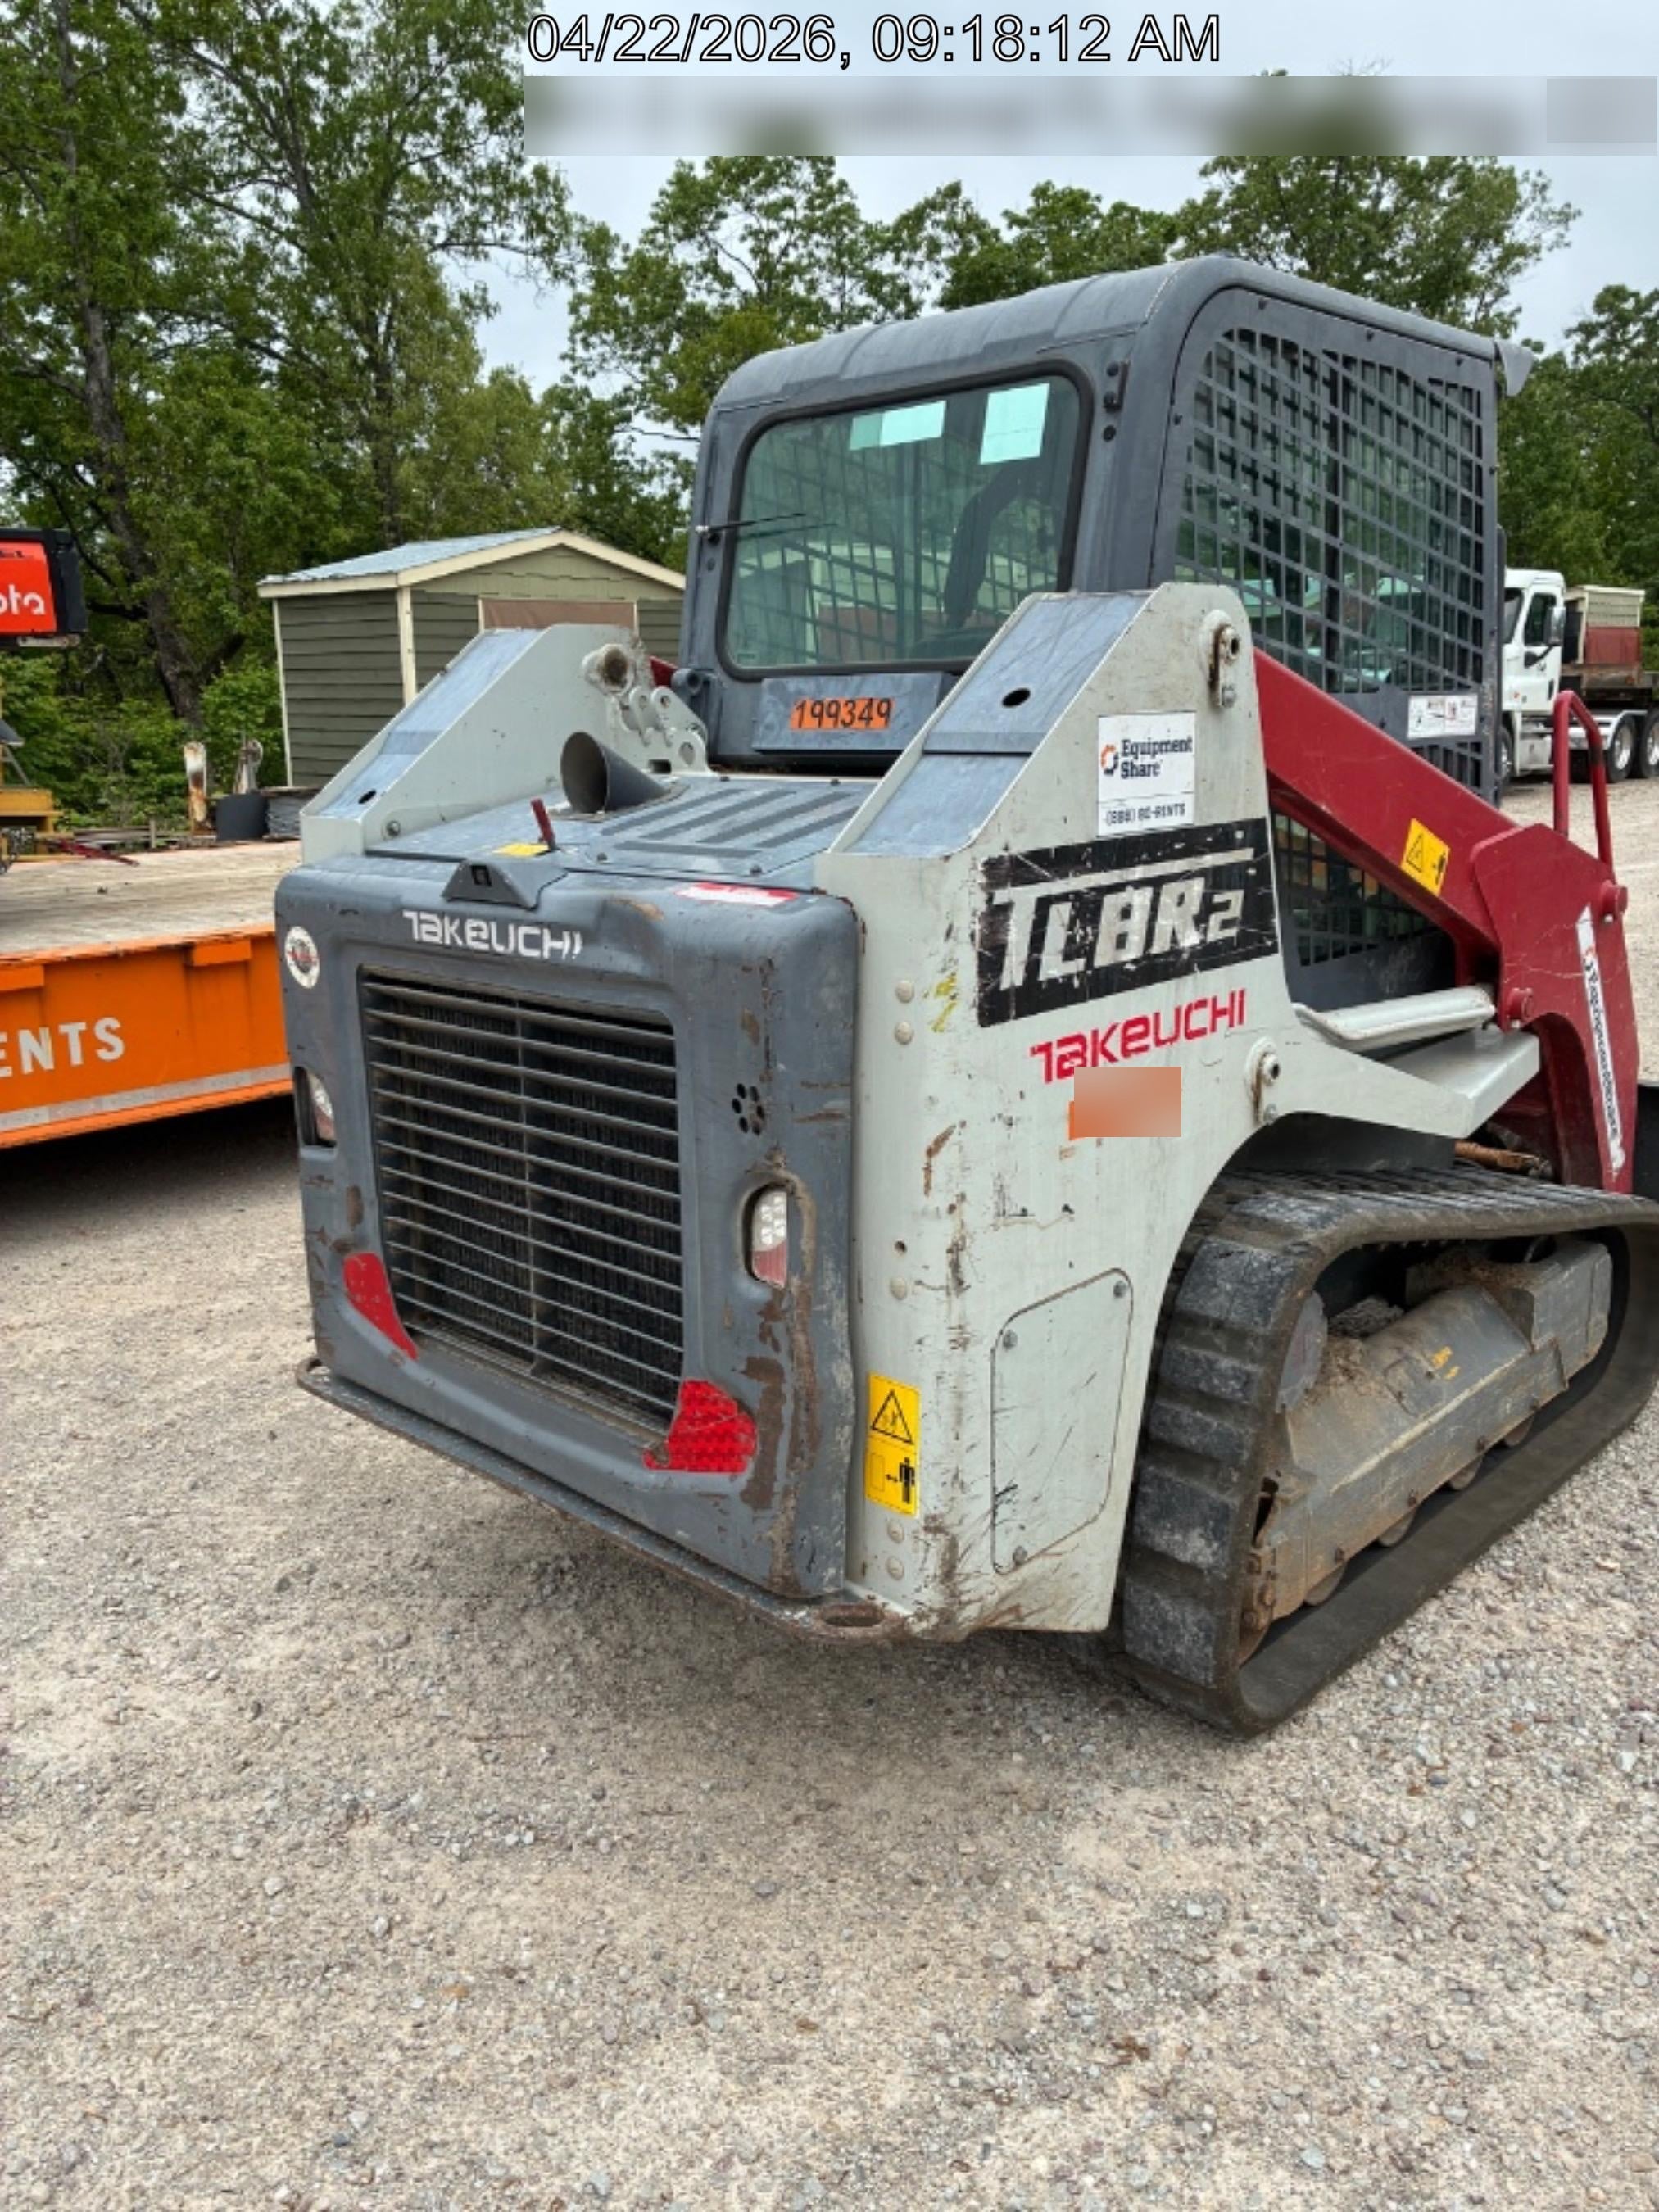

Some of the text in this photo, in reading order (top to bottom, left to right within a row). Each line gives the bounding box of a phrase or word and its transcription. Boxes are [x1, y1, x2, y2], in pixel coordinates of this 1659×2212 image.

[796, 698, 891, 728] 199349
[1121, 736, 1193, 759] Equipment
[1120, 760, 1161, 779] Share
